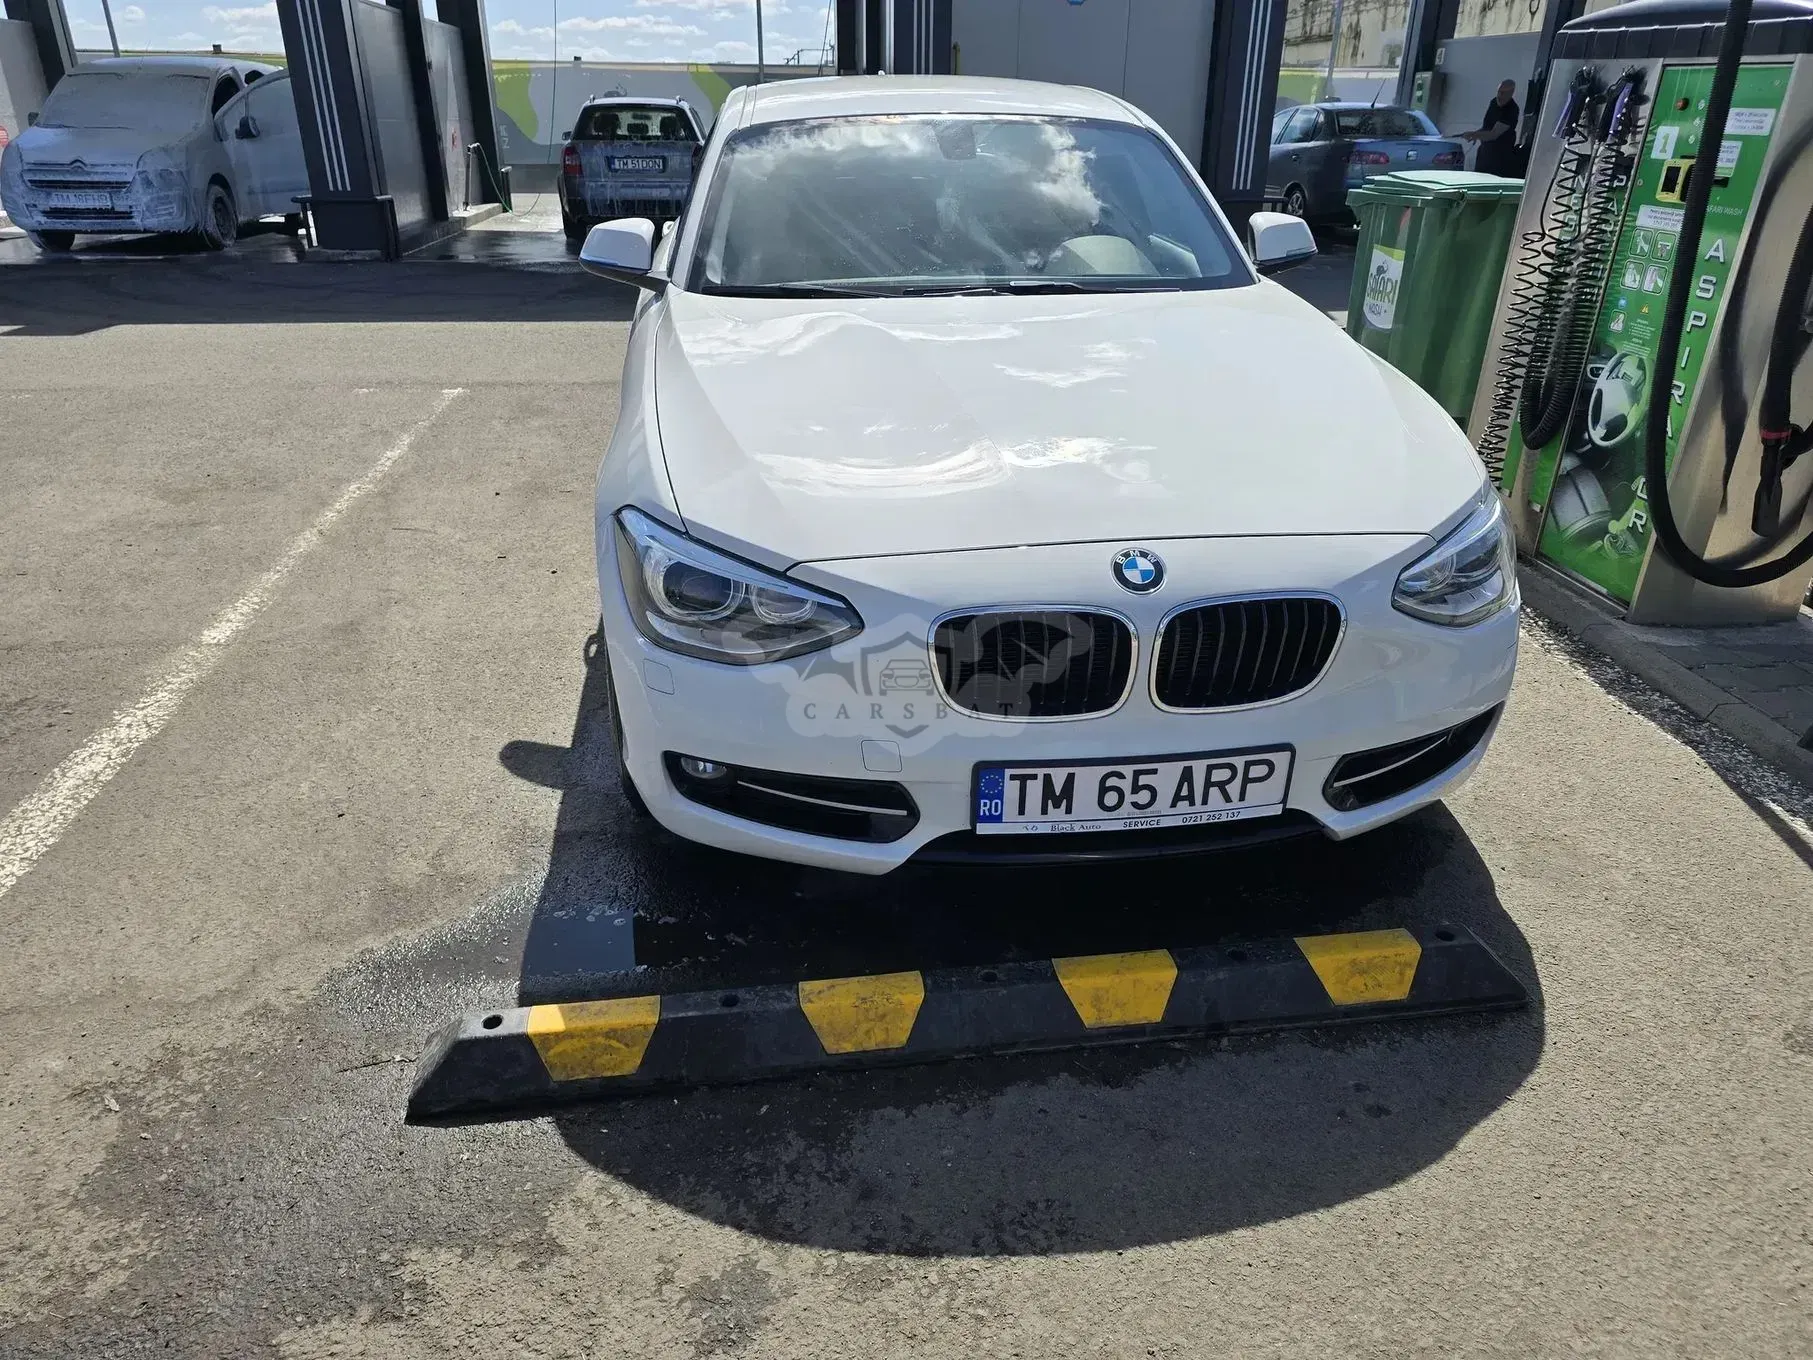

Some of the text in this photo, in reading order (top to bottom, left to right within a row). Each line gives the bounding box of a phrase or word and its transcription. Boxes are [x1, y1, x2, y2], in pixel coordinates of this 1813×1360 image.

[1659, 133, 1670, 154] 1
[1009, 758, 1276, 816] TM 65 ARP
[980, 799, 1001, 816] RO
[1050, 824, 1076, 832] Black
[1122, 818, 1161, 828] SERVICE
[1181, 815, 1203, 824] 0721
[1206, 813, 1222, 821] 252
[1225, 811, 1241, 819] 137
